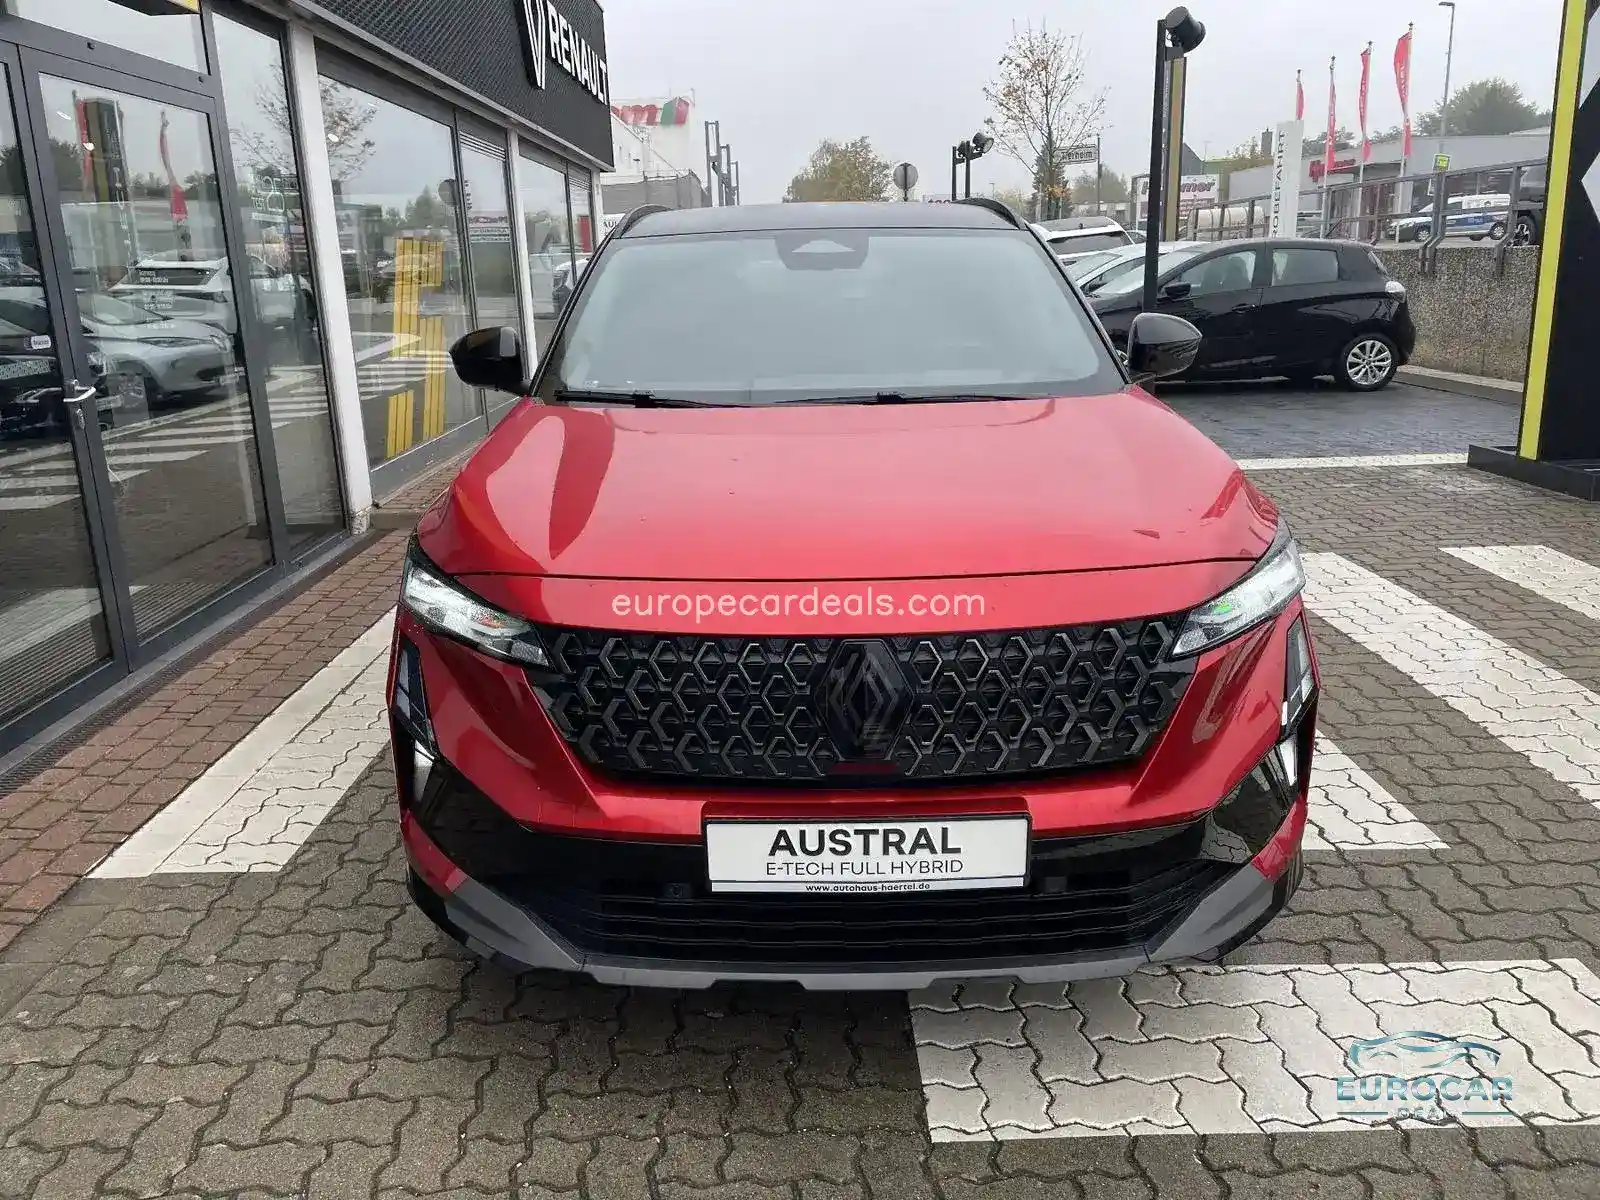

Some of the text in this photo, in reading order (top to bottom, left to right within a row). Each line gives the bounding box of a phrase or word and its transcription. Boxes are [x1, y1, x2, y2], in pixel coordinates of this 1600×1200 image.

[547, 0, 608, 105] RENAULT
[768, 827, 961, 857] AUSTRAL
[766, 858, 964, 876] E-TECH FULL HYBRID
[805, 882, 931, 893] www.autohaus-haertel.de
